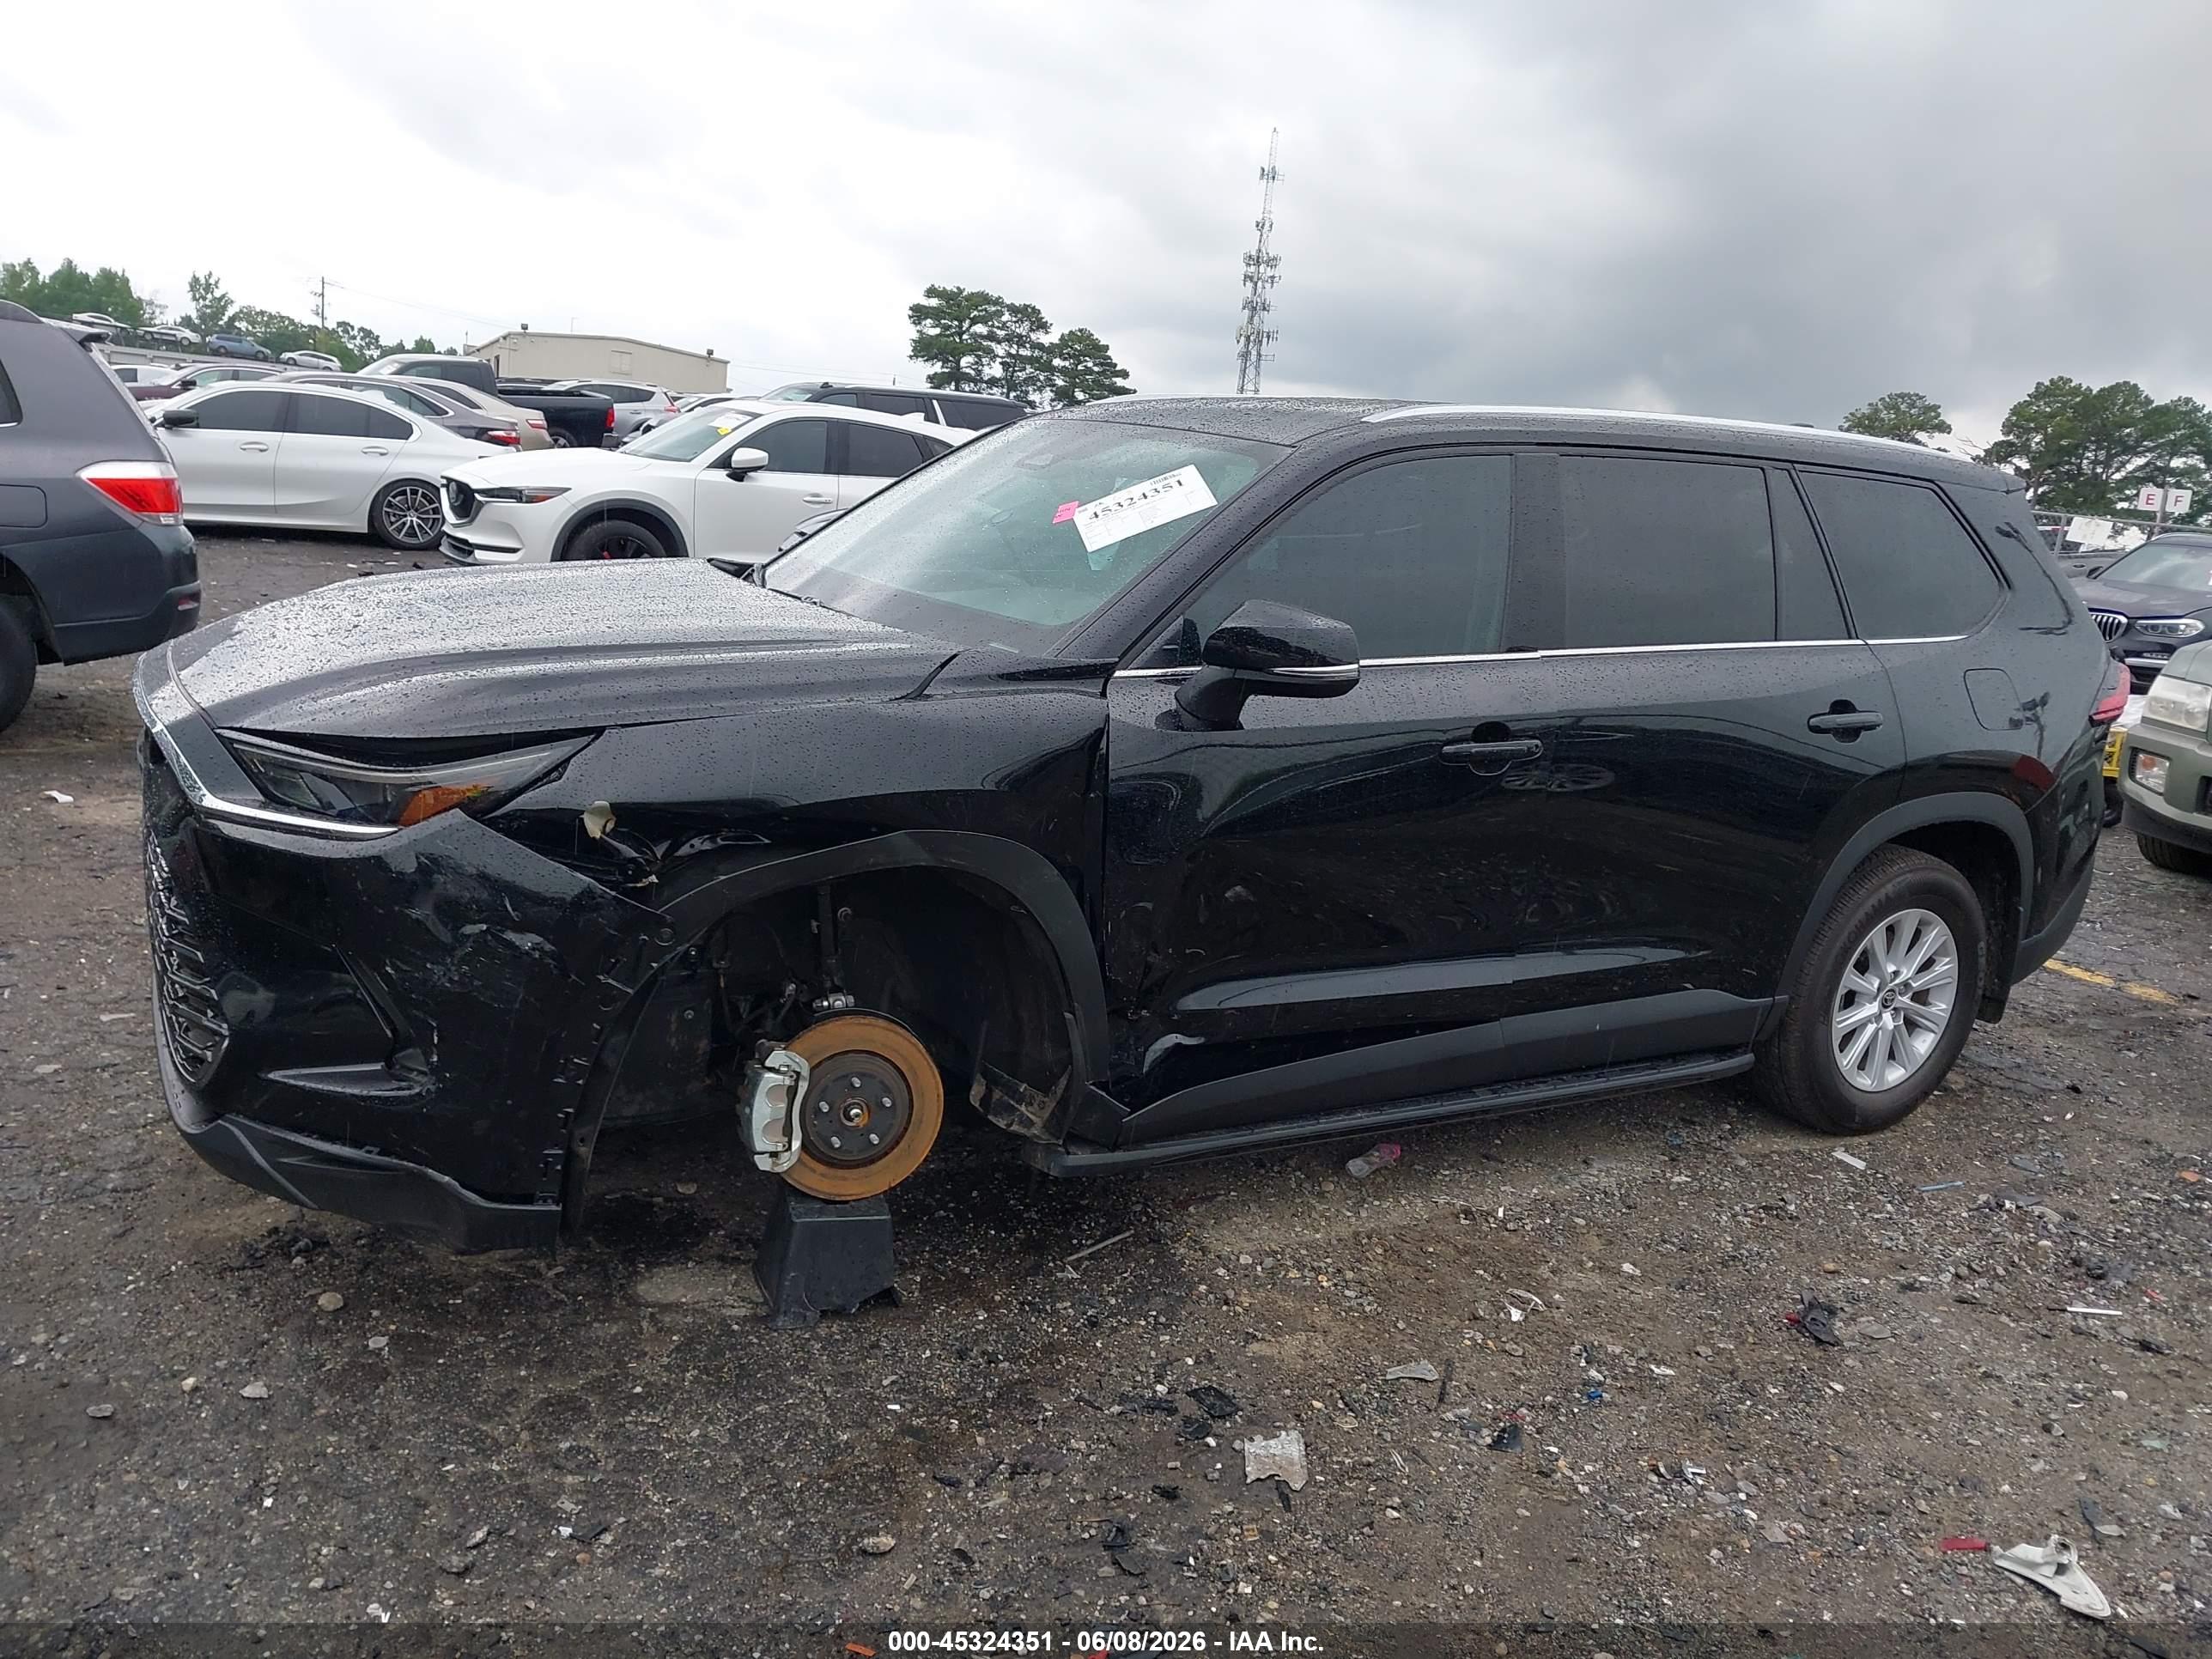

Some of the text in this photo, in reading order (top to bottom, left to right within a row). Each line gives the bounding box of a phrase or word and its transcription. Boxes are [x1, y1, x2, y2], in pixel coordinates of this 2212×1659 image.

[1088, 479, 1184, 520] 45324351
[2145, 493, 2156, 506] E
[2173, 495, 2185, 507] F
